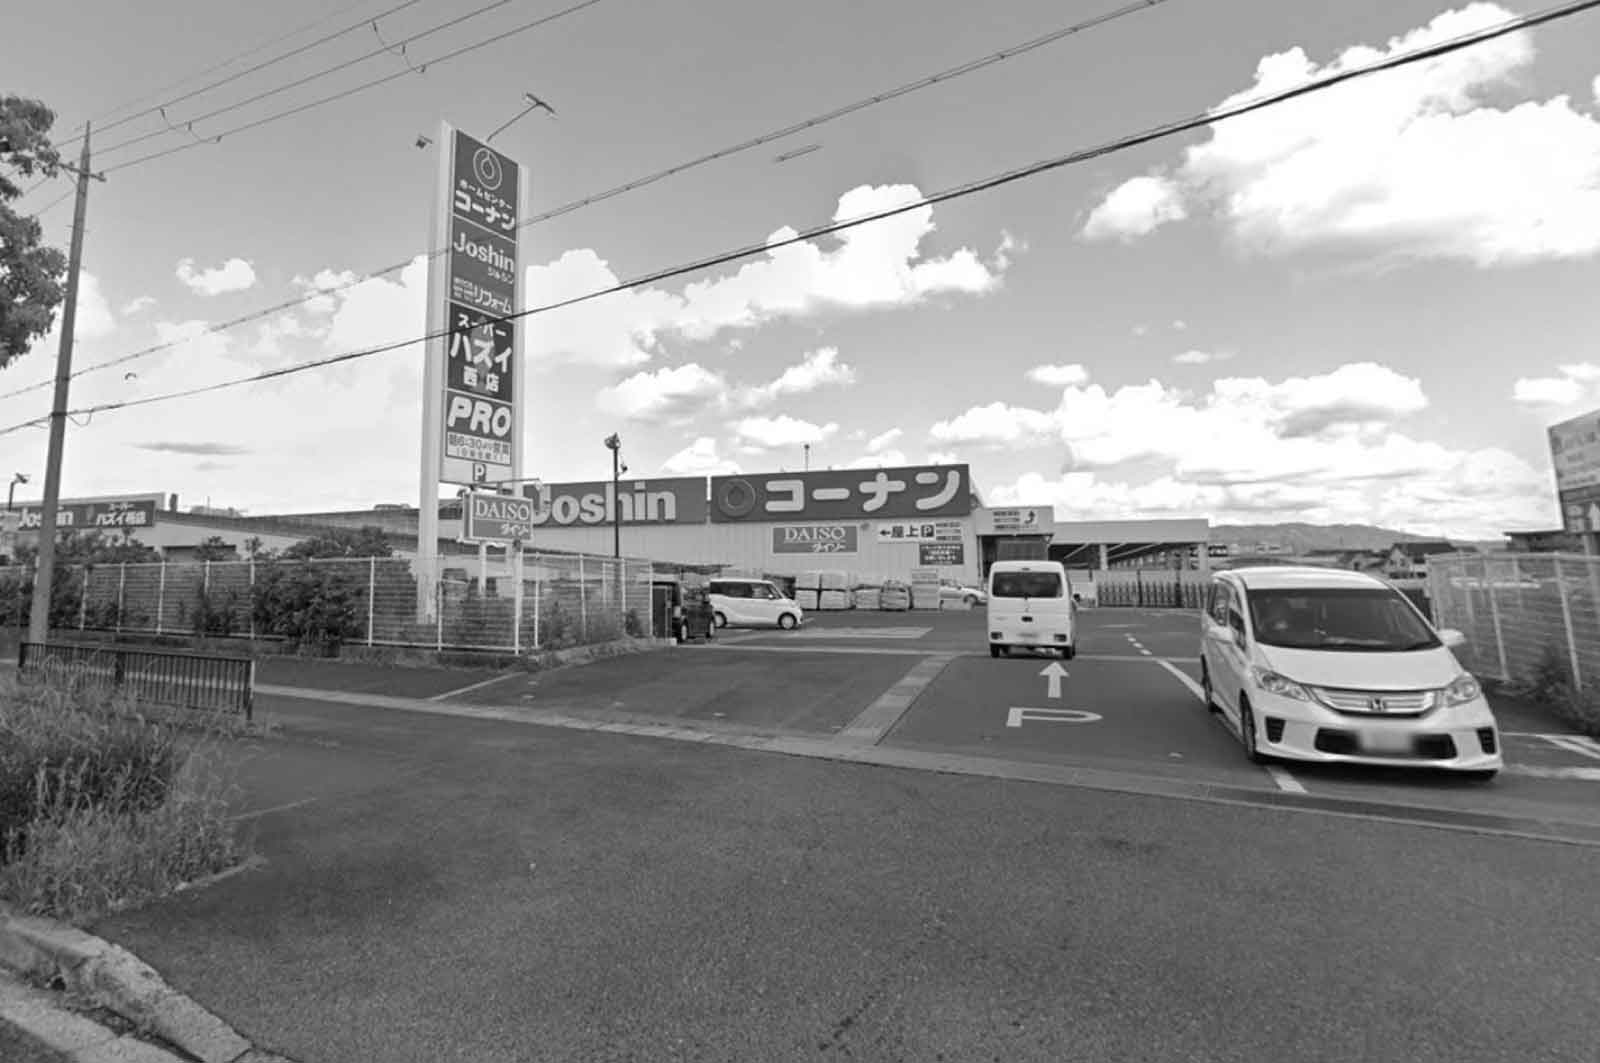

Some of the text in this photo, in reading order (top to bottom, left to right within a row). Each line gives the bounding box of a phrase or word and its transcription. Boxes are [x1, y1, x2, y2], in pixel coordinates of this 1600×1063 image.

[460, 179, 513, 210] ホームセンター
[455, 190, 515, 231] コーナン
[453, 232, 514, 272] Joshin
[473, 284, 512, 314] リフォーム
[458, 313, 507, 337] スーパー
[450, 332, 512, 373] ハズイ
[447, 396, 512, 437] PRO
[473, 463, 487, 481] P
[533, 480, 677, 525] Joshin
[765, 470, 960, 512] コーナン
[476, 499, 530, 521] DAISO
[784, 527, 847, 542] DAISO
[1006, 706, 1103, 728] P
